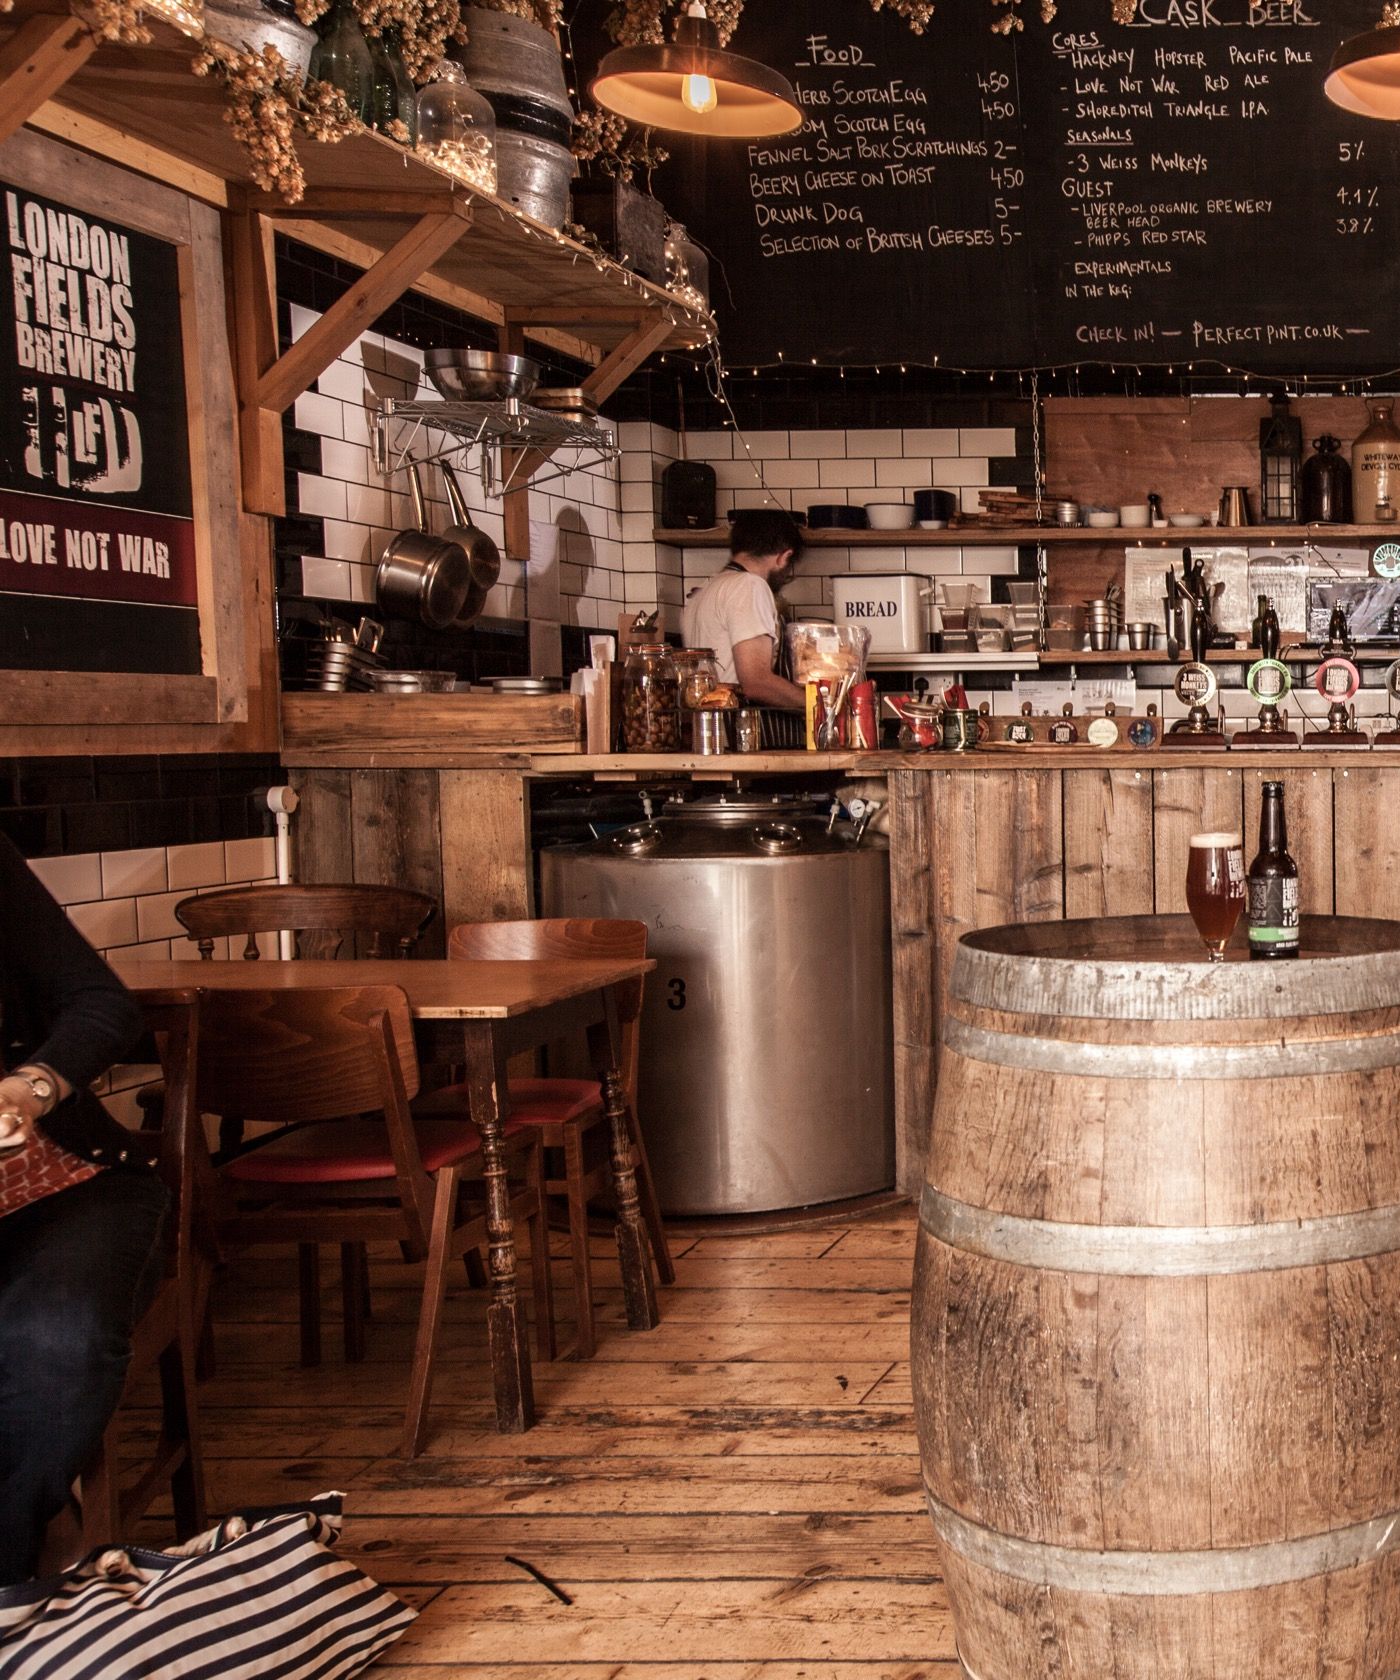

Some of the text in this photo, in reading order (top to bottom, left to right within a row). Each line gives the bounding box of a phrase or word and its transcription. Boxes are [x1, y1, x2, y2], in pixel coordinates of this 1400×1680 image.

[1072, 46, 1134, 73] HACKNEY
[1285, 47, 1312, 64] PALE
[1076, 74, 1269, 94] LOVE NOT WAR RED ALE
[1076, 100, 1229, 120] SHOREDITCH TRIANGLE
[748, 145, 812, 166] FENNEL
[817, 139, 852, 162] SALT
[893, 136, 987, 158] SCRATCHINGS
[1099, 153, 1207, 174] WEISS MONKEYS
[750, 163, 935, 197] BEERY CHEESE ON TOAST
[1062, 178, 1113, 198] GUEST
[756, 203, 863, 227] DRUNK DOG
[1083, 200, 1271, 216] LIVERPOOL ORGANIC BREWERY
[1087, 216, 1159, 229] BEER HEAD
[6, 191, 130, 287] LONDON
[760, 226, 994, 257] SELECTION OF BRITISH CHEESES
[1143, 231, 1167, 244] RED
[1172, 230, 1206, 244] STAR
[11, 253, 136, 350] FIELDS
[1082, 285, 1103, 297] THE
[1076, 320, 1261, 347] CHECK PERFECT
[15, 321, 136, 393] BREWERY
[0, 517, 170, 578] LOVE NOT WAR
[845, 601, 897, 618] BREAD
[667, 978, 686, 1010] 3
